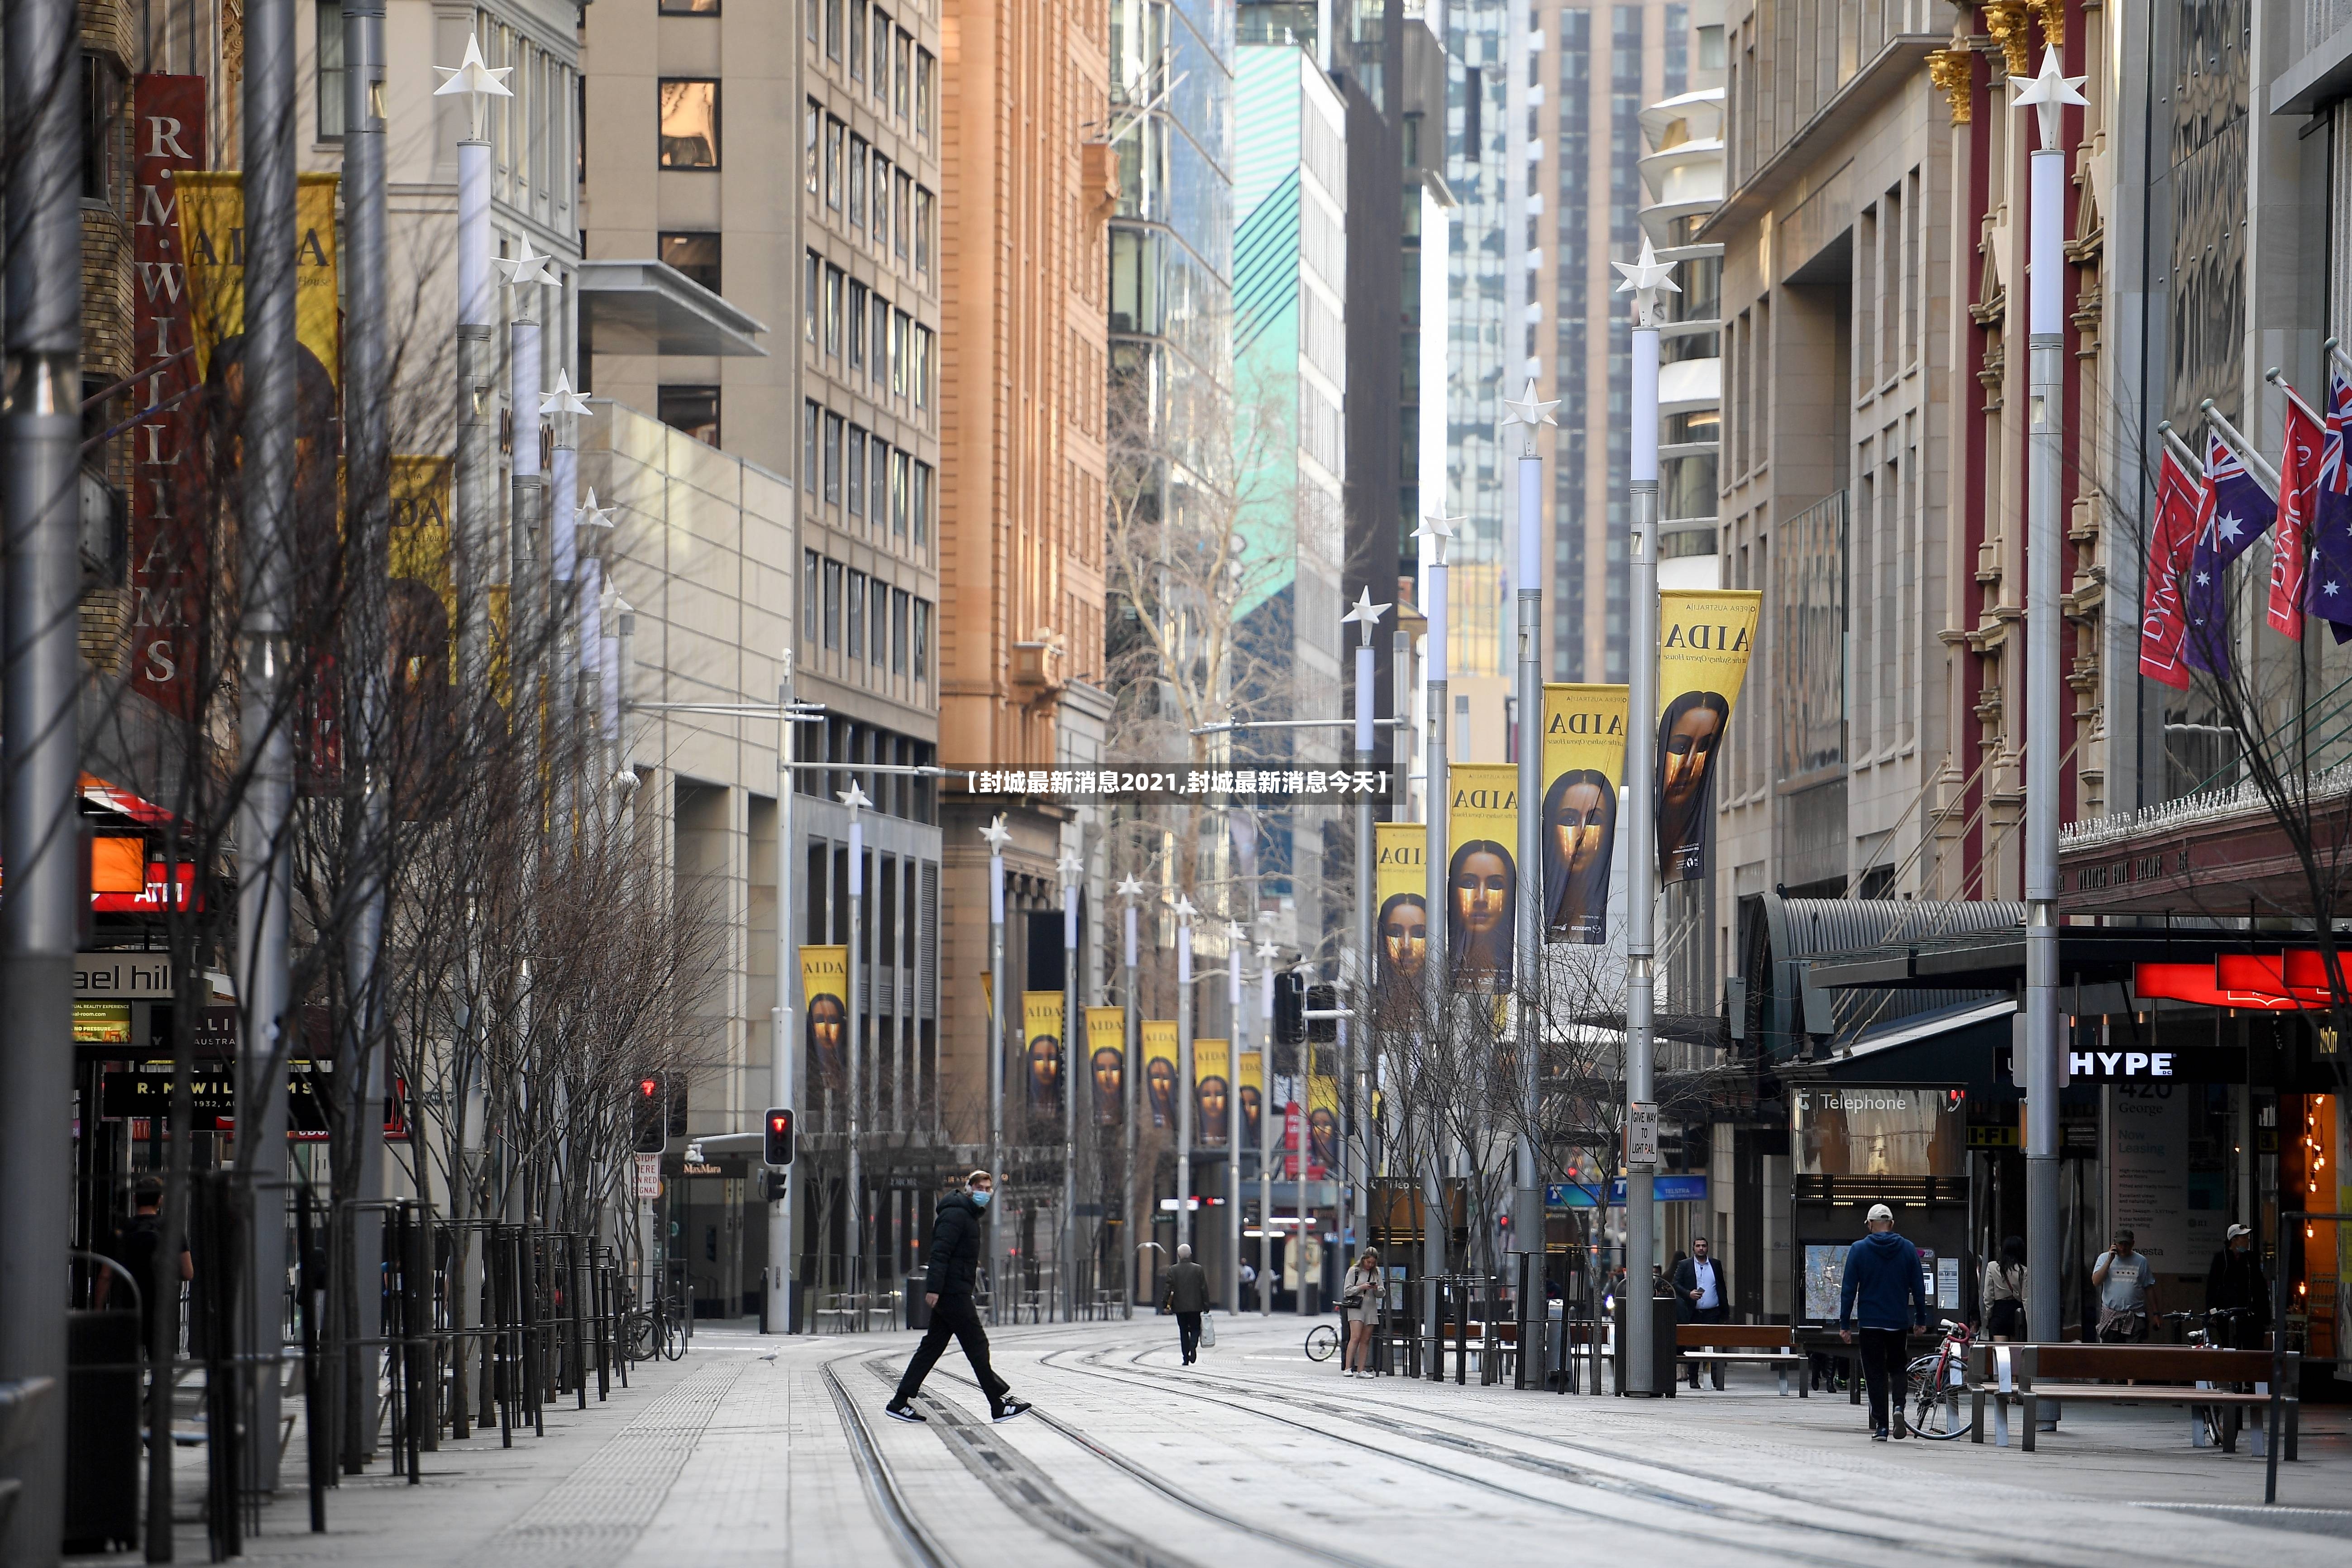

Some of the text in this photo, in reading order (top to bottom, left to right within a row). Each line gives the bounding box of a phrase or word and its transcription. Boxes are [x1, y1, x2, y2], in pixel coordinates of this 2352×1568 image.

[190, 228, 330, 267] AIA
[804, 961, 844, 973] AIDA
[1026, 1006, 1061, 1017] AIDA
[1090, 1021, 1122, 1030] AIDA
[1145, 1032, 1176, 1042] AIDA
[1199, 1052, 1226, 1061] AIDA
[1240, 1064, 1261, 1072] IDA
[2070, 1052, 2172, 1076] HYPE
[1820, 1094, 1906, 1114] Telephone
[2119, 1103, 2163, 1116] George
[1633, 1112, 1657, 1123] GIVE WAY
[1641, 1128, 1648, 1138] TO
[2119, 1130, 2145, 1140] Now
[1632, 1143, 1655, 1154] LIGHT RAIL
[2119, 1143, 2166, 1156] Leasing
[640, 1165, 655, 1173] ERE
[683, 1163, 722, 1174] MaxMara
